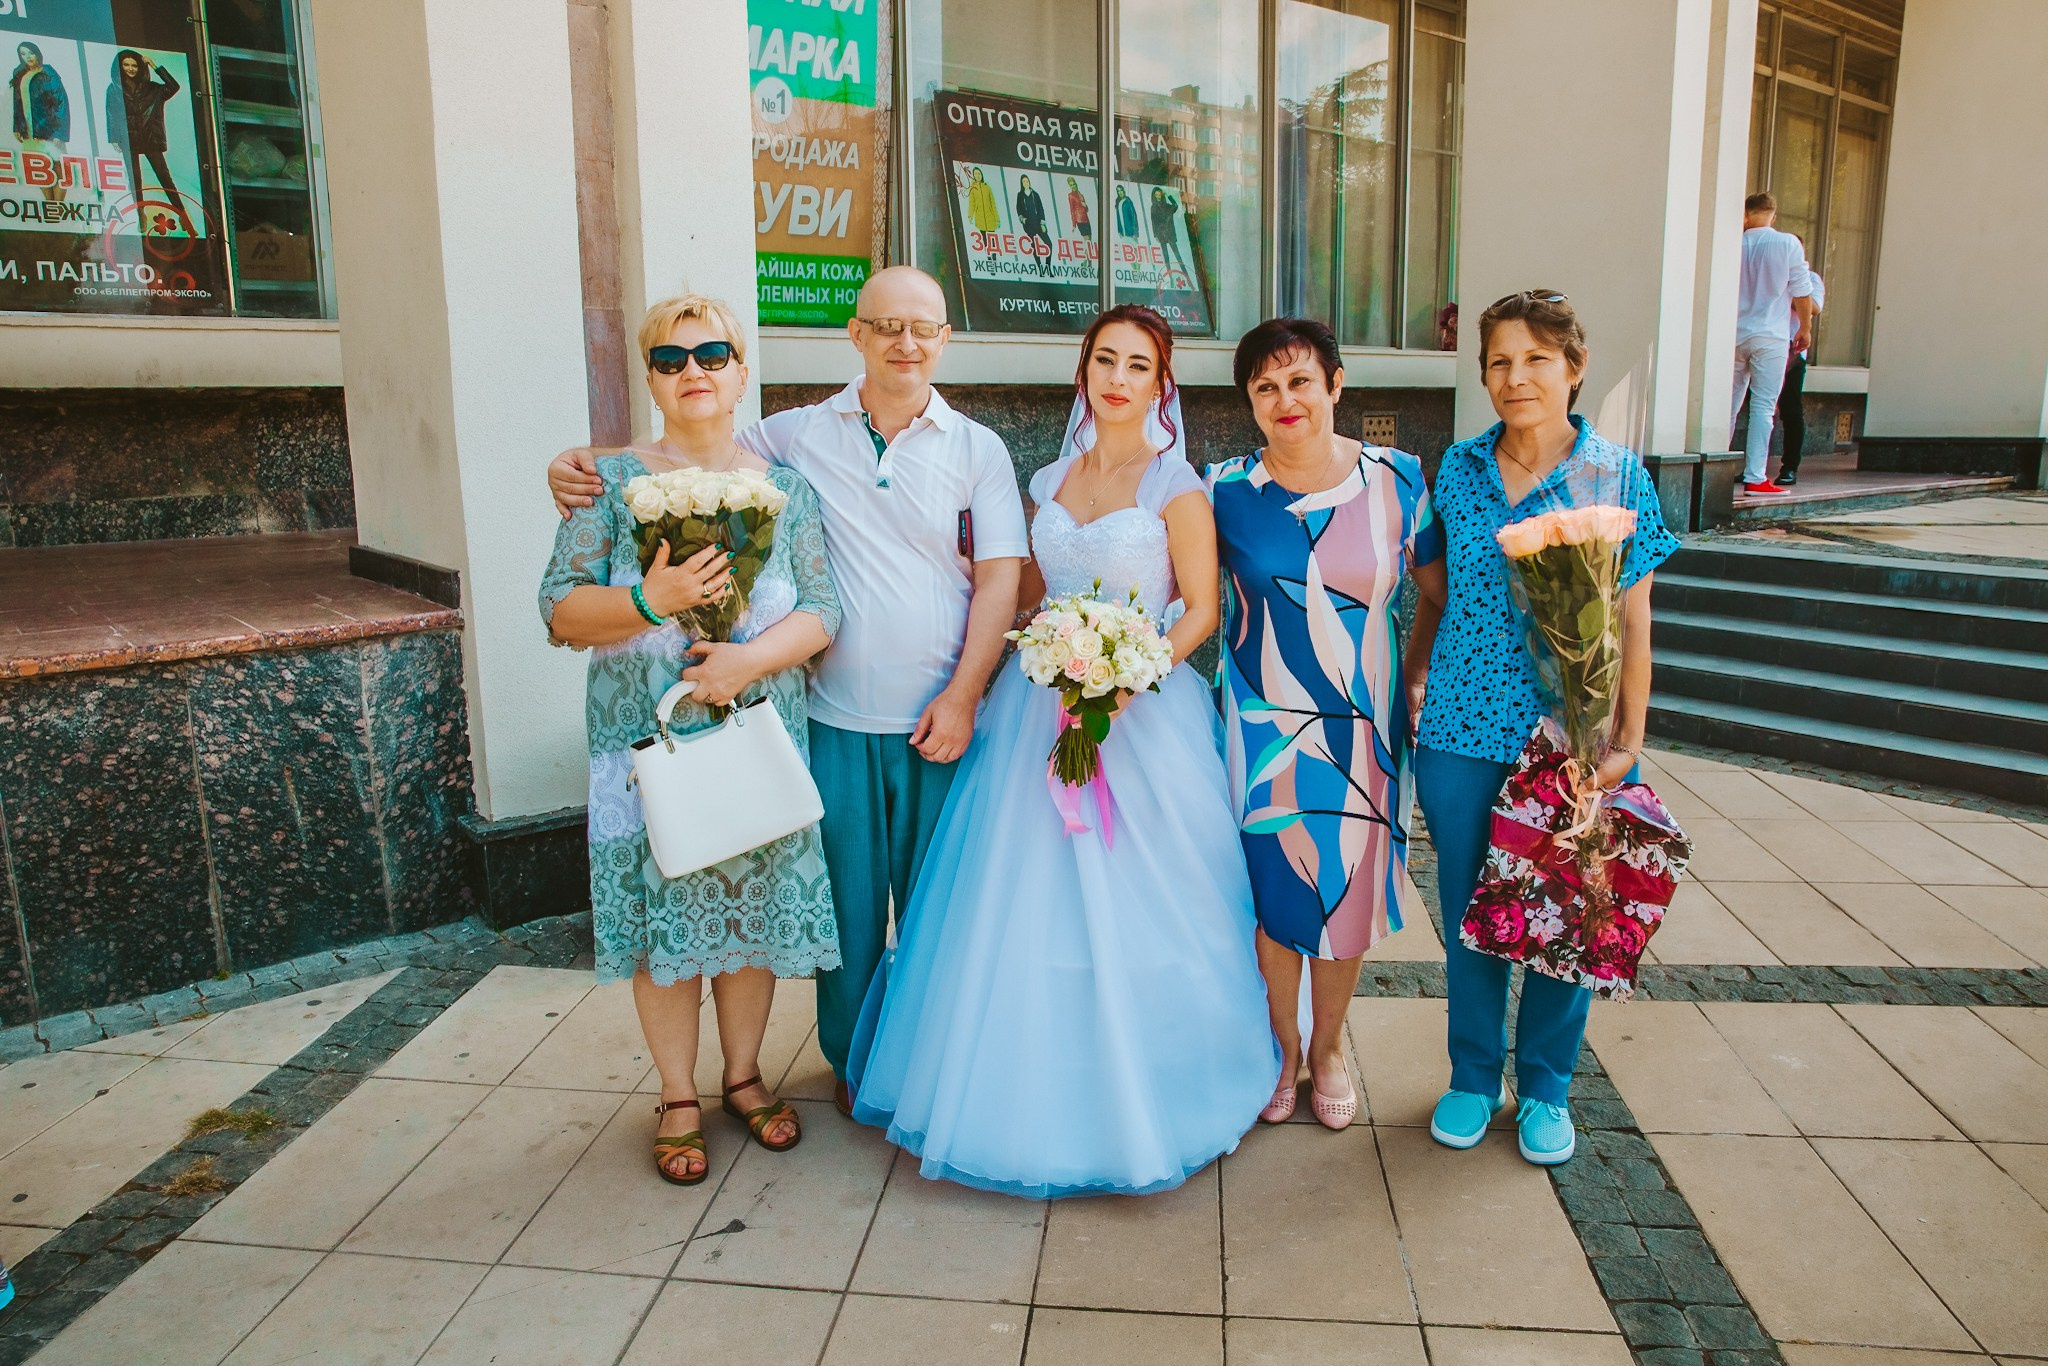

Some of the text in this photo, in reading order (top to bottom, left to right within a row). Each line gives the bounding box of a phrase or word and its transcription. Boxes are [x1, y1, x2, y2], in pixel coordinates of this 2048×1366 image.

[947, 102, 1170, 154] ОПТОВАЯ ЯРАРКА
[752, 132, 860, 171] РОДАЖА
[1017, 141, 1119, 174] ОДЕЖД
[0, 198, 125, 226] ОДЕЖДА
[753, 180, 853, 238] УВИ
[970, 231, 1050, 257] ЗДЕСЬ
[36, 260, 163, 285] ПАЛЬТО.
[821, 263, 865, 281] КОЖА
[973, 259, 1037, 276] ЖЕНСКАЯ
[1052, 265, 1098, 279] МУЖСК
[1115, 269, 1165, 284] ОДЕЖДА
[74, 287, 98, 296] ООО
[1000, 297, 1055, 315] КУРТКИ,
[1058, 301, 1099, 315] ВЕТРО
